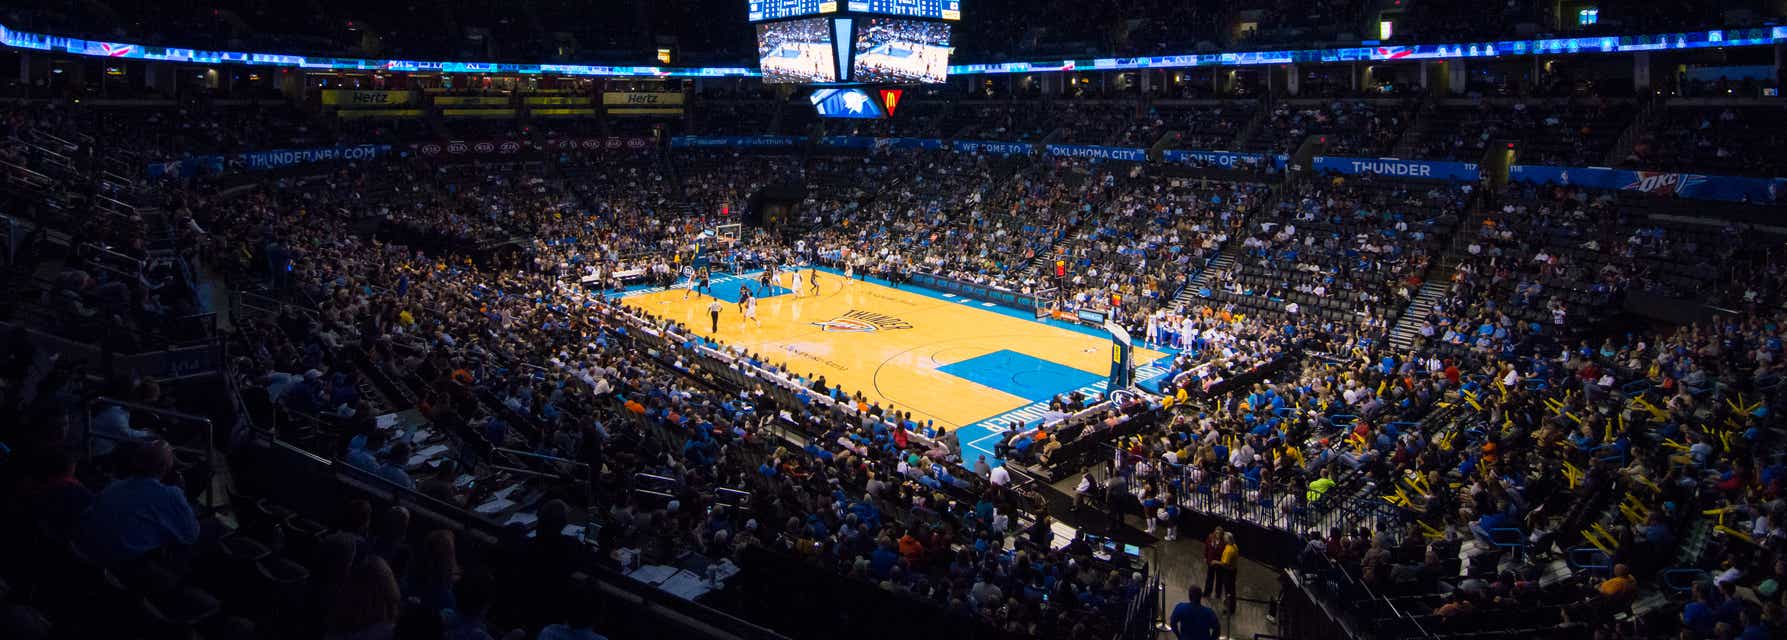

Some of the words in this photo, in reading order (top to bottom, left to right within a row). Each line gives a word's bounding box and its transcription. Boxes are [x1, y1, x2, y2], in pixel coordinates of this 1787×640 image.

[628, 94, 659, 104] Hertz
[1053, 147, 1109, 158] OKLAHOMA
[1111, 150, 1135, 160] CITY
[1219, 155, 1237, 165] OF
[1352, 161, 1431, 177] THUNDER
[843, 309, 914, 330] THUNDER
